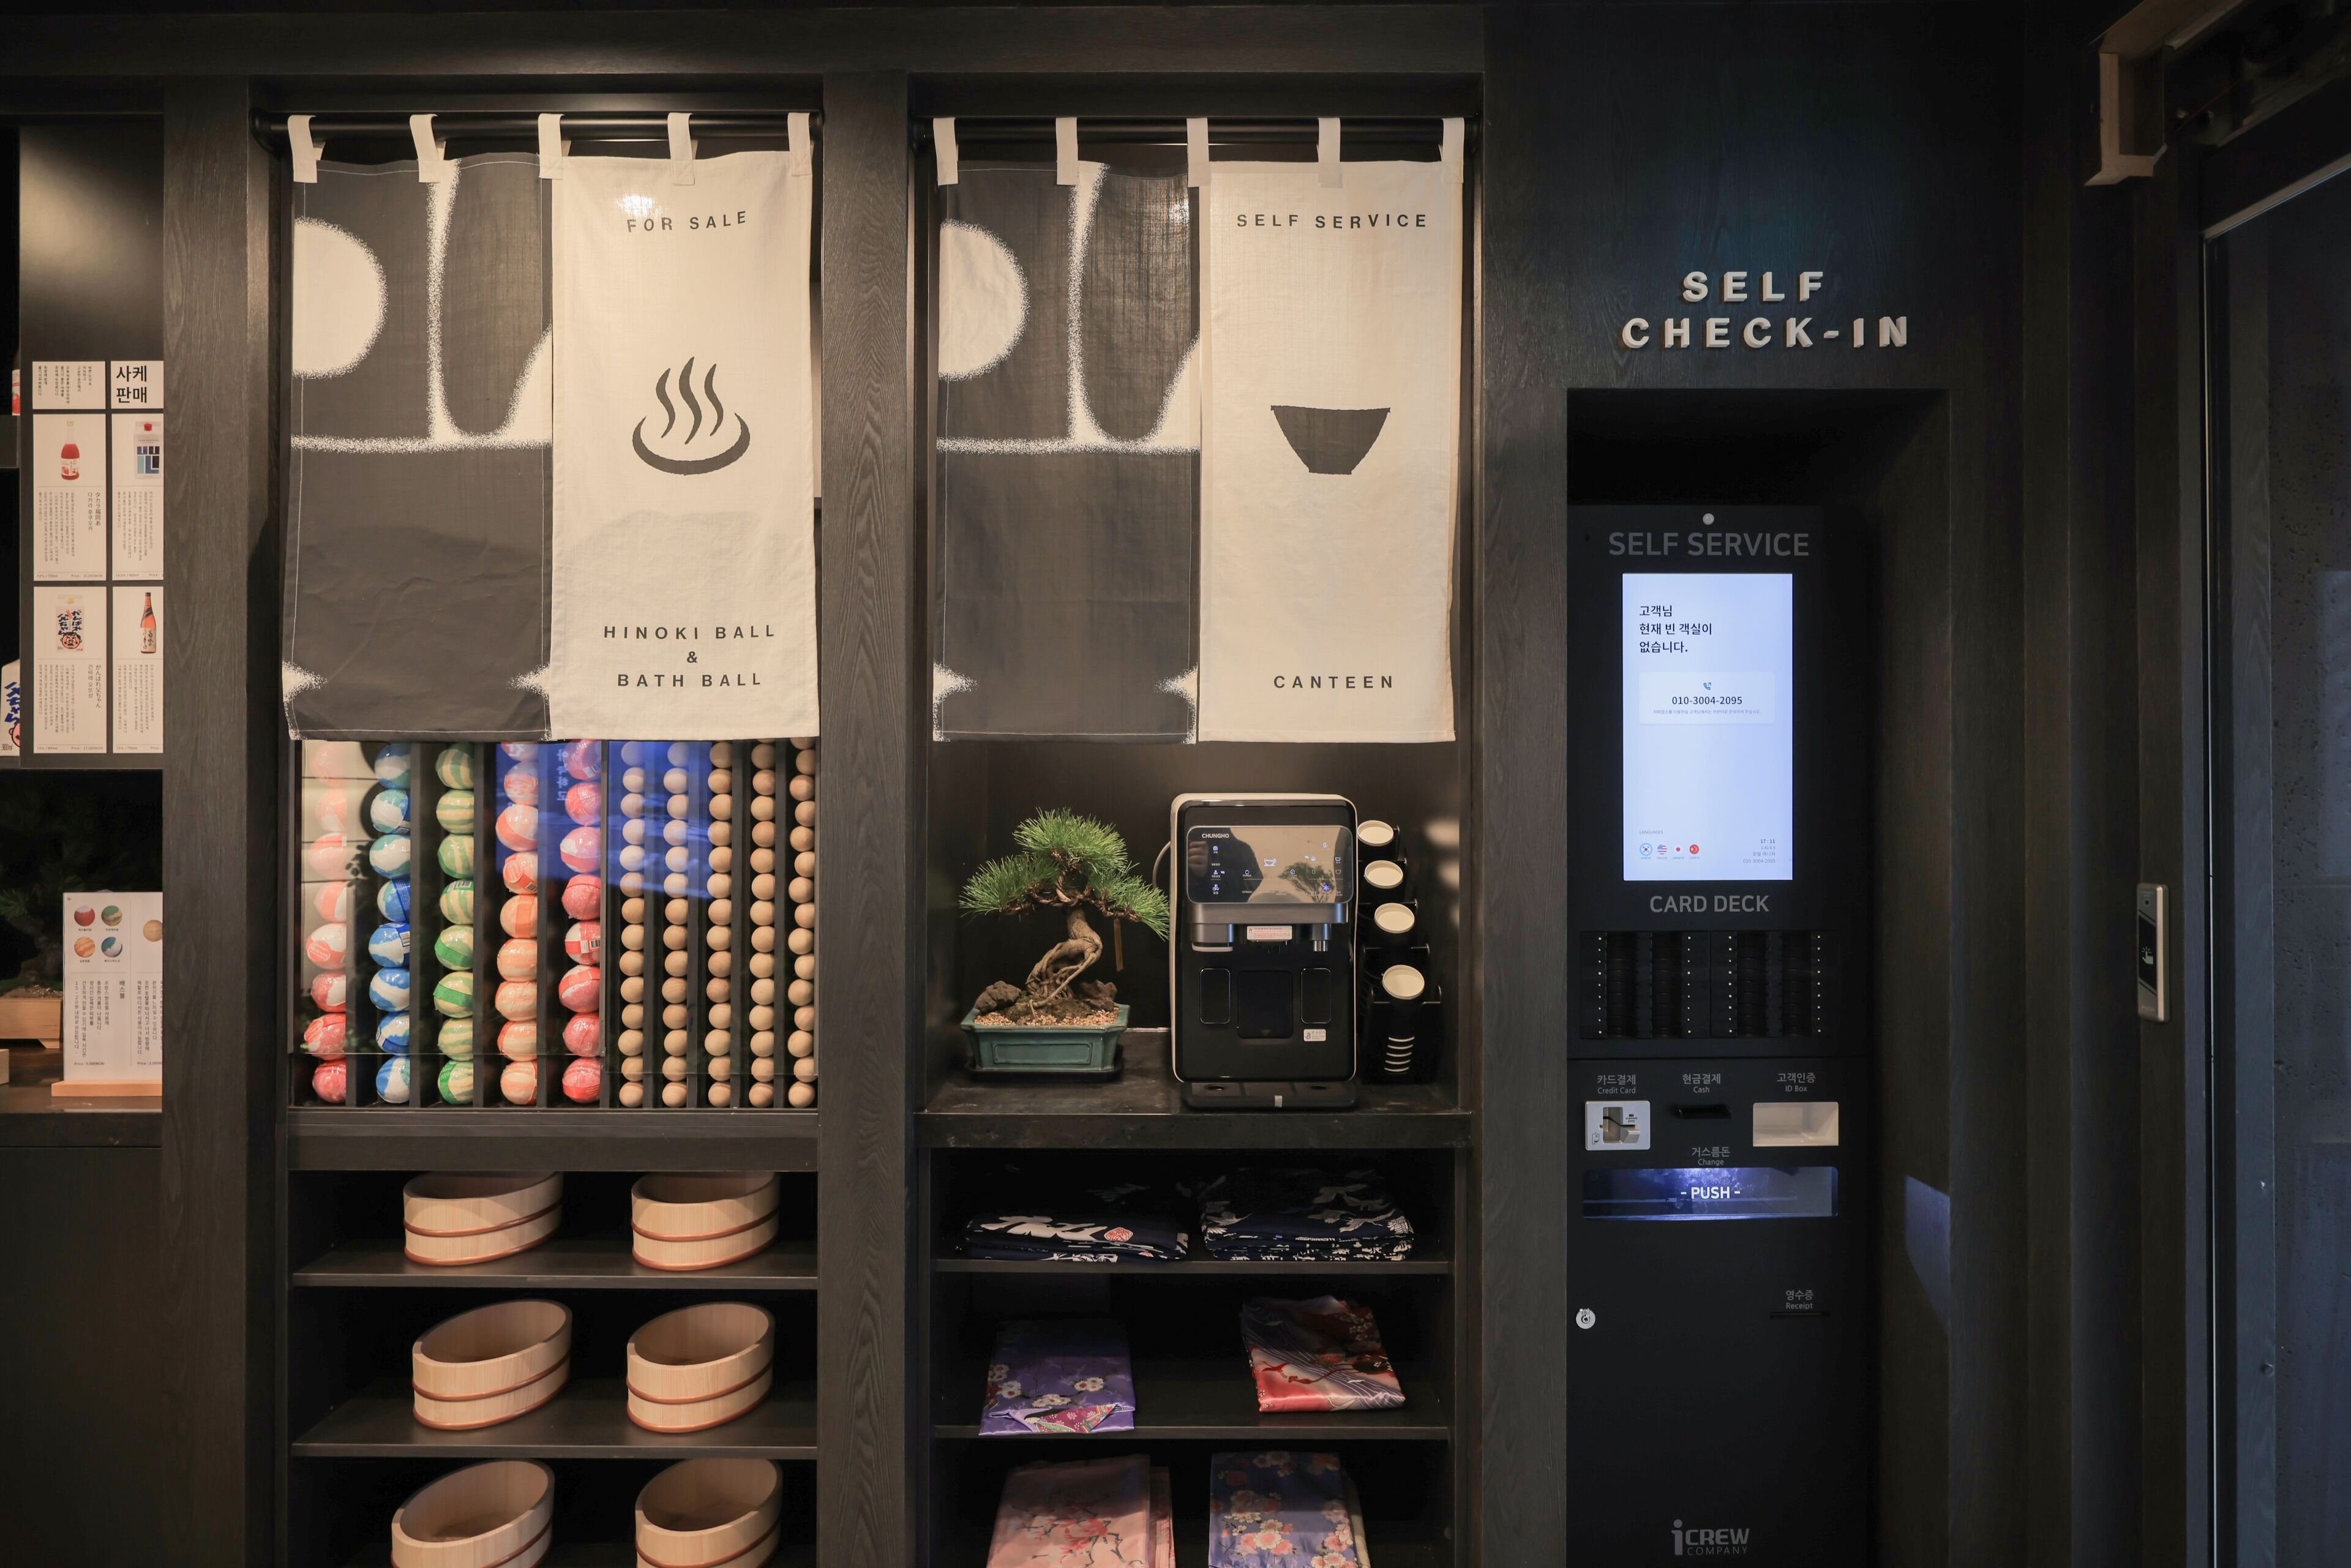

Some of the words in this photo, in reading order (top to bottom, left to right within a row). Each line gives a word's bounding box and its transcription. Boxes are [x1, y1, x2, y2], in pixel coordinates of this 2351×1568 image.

[626, 217, 673, 233] FOR
[689, 211, 746, 230] SALE
[1237, 214, 1299, 227] SELF
[1315, 214, 1426, 229] SERVICE
[1682, 271, 1824, 302] SELF
[1621, 316, 1908, 349] CHECK-IN
[116, 365, 147, 383] 사케
[116, 386, 147, 403] 판매
[1608, 531, 1679, 556] SELF
[1687, 532, 1809, 557] SERVICE
[1639, 605, 1672, 617] 고객님
[604, 626, 698, 640] HINOKI
[715, 625, 774, 639] BALL
[1639, 623, 1661, 636] 현재
[1665, 623, 1675, 635] 빈
[1679, 623, 1712, 636] 객실이
[1639, 641, 1688, 653] 없습니다.
[686, 651, 697, 664] &
[617, 673, 684, 688] BATH
[702, 673, 760, 687] BALL
[1273, 675, 1392, 689] CANTEEN
[1672, 696, 1742, 705] 010-3004-2095
[1650, 895, 1707, 913] CARD
[1714, 895, 1769, 912] DECK
[1597, 1074, 1636, 1086] 카드결제
[1682, 1073, 1721, 1085] 현금결제
[1776, 1072, 1816, 1083] 고객인증
[1692, 1146, 1731, 1158] 거스름돈
[1690, 1186, 1730, 1199] PUSH
[1785, 1289, 1814, 1301] 영수증
[1785, 1302, 1813, 1310] Receipt
[1686, 1543, 1747, 1556] COMPANY
